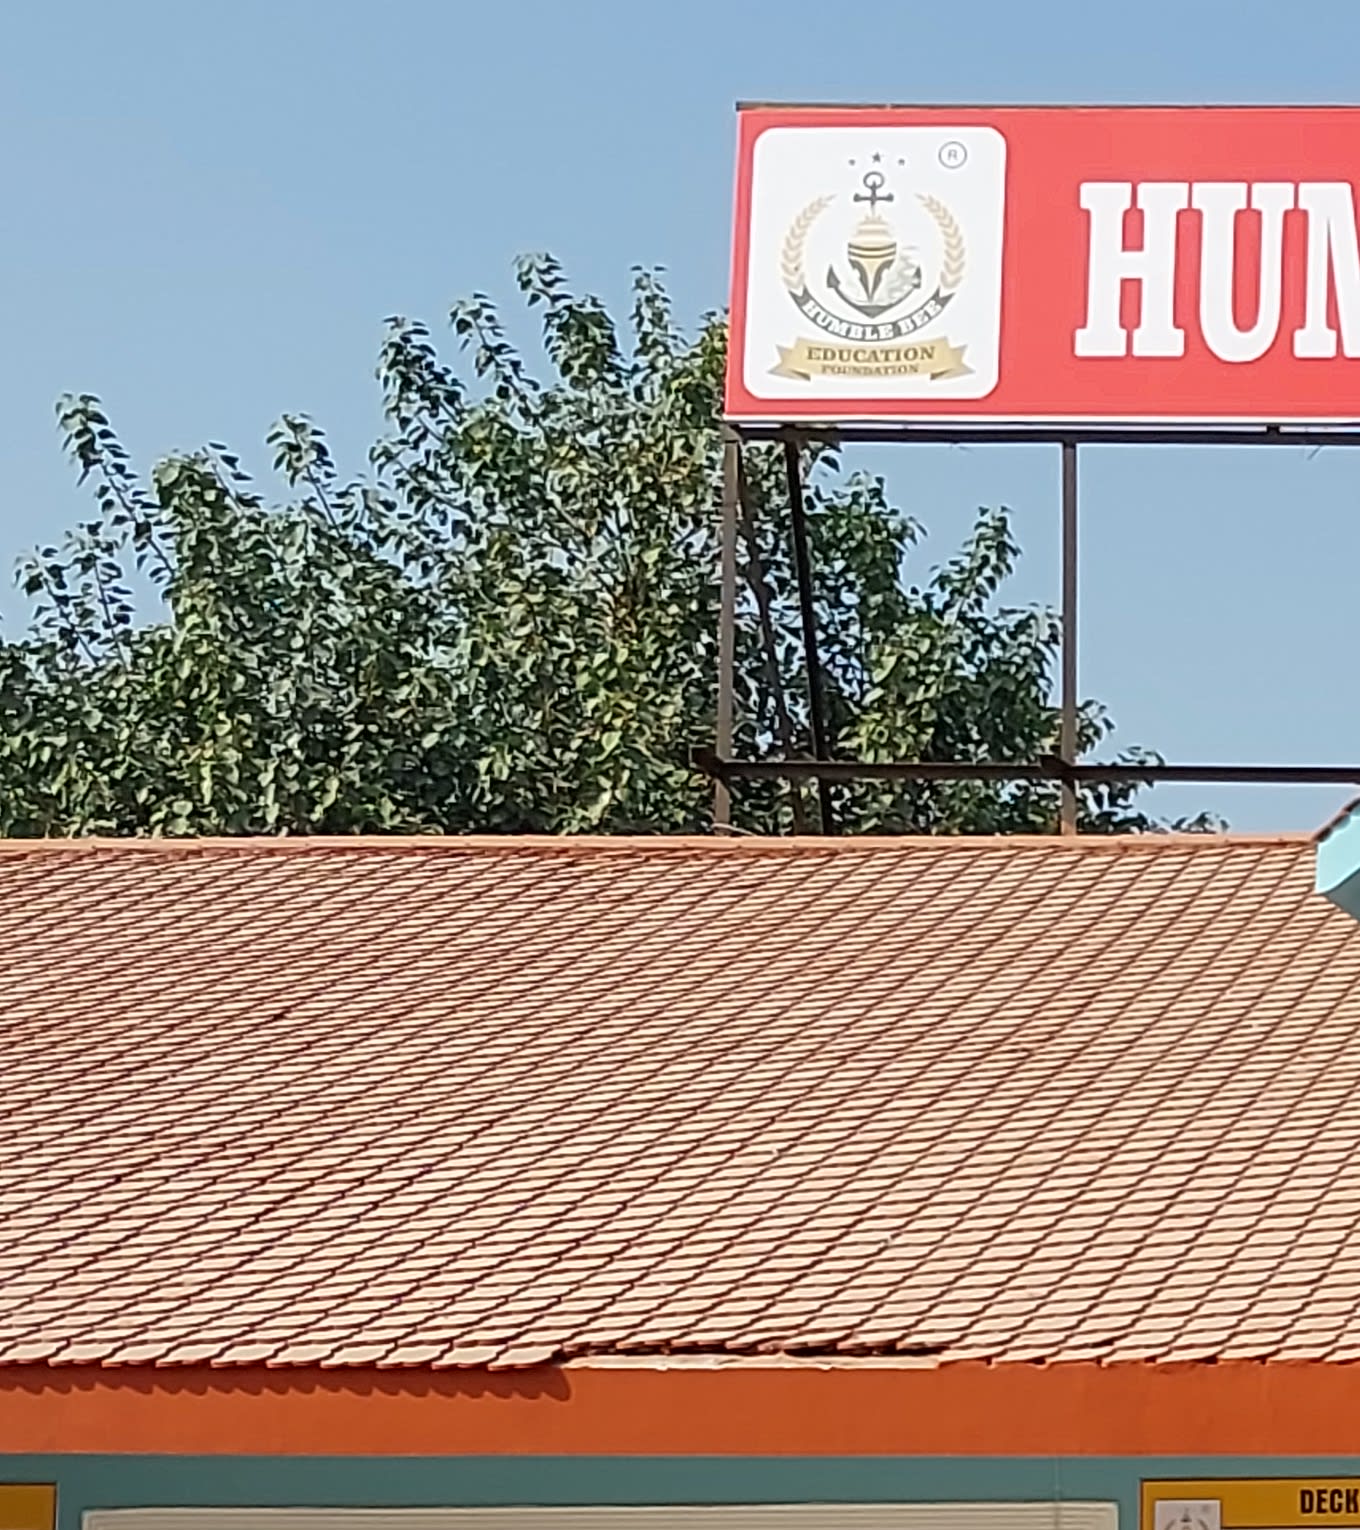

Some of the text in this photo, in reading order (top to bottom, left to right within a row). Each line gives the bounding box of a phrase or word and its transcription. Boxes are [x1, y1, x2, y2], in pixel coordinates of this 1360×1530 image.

[801, 299, 943, 340] HUMBLE BEE
[806, 345, 936, 363] EDUCATION
[821, 363, 919, 376] FOUNDATION
[1299, 1488, 1360, 1514] DECK
